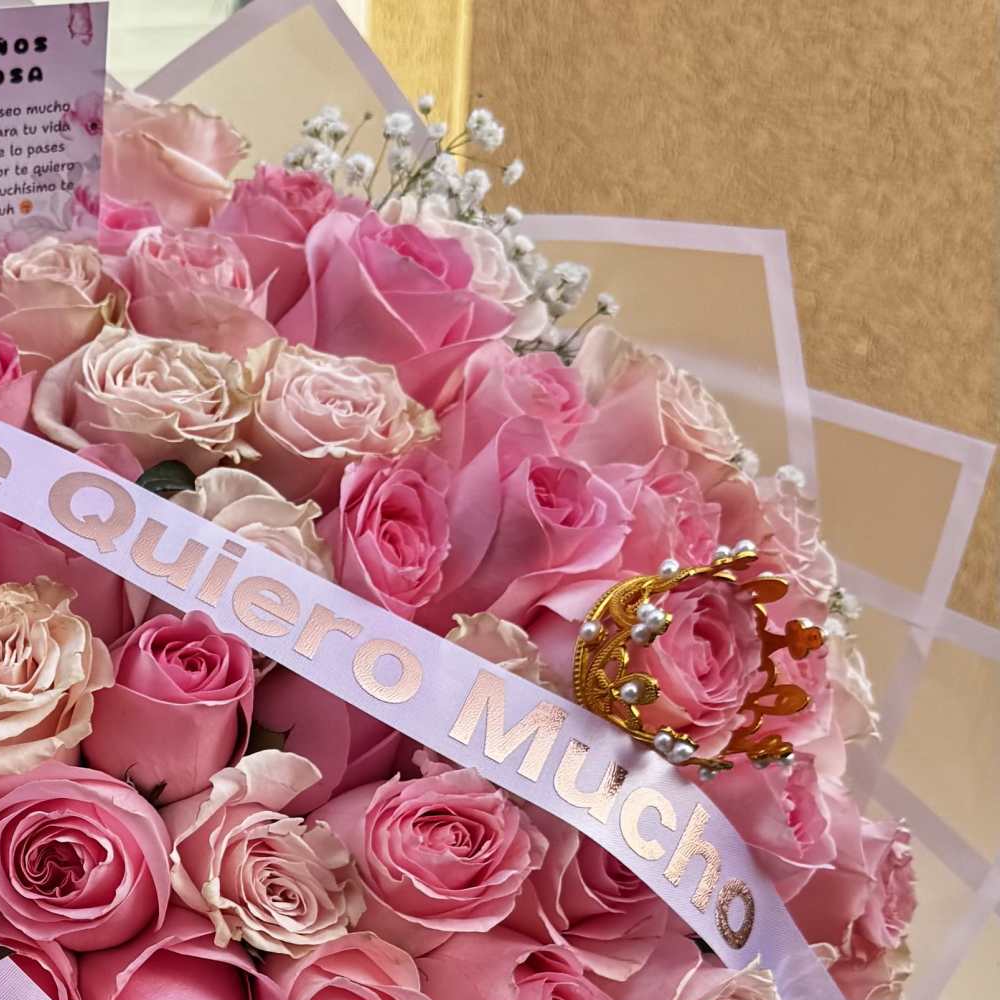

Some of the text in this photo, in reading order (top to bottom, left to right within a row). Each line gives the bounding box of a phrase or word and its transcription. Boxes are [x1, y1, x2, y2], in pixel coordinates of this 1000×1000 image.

[26, 100, 71, 115] mucho
[23, 123, 38, 136] tu
[42, 119, 71, 134] vida
[9, 144, 23, 157] lo
[27, 143, 66, 159] pases
[14, 164, 29, 177] te
[33, 161, 76, 177] quiero
[60, 180, 75, 192] te
[47, 470, 425, 705] Quiero
[448, 667, 756, 951] Mucho
